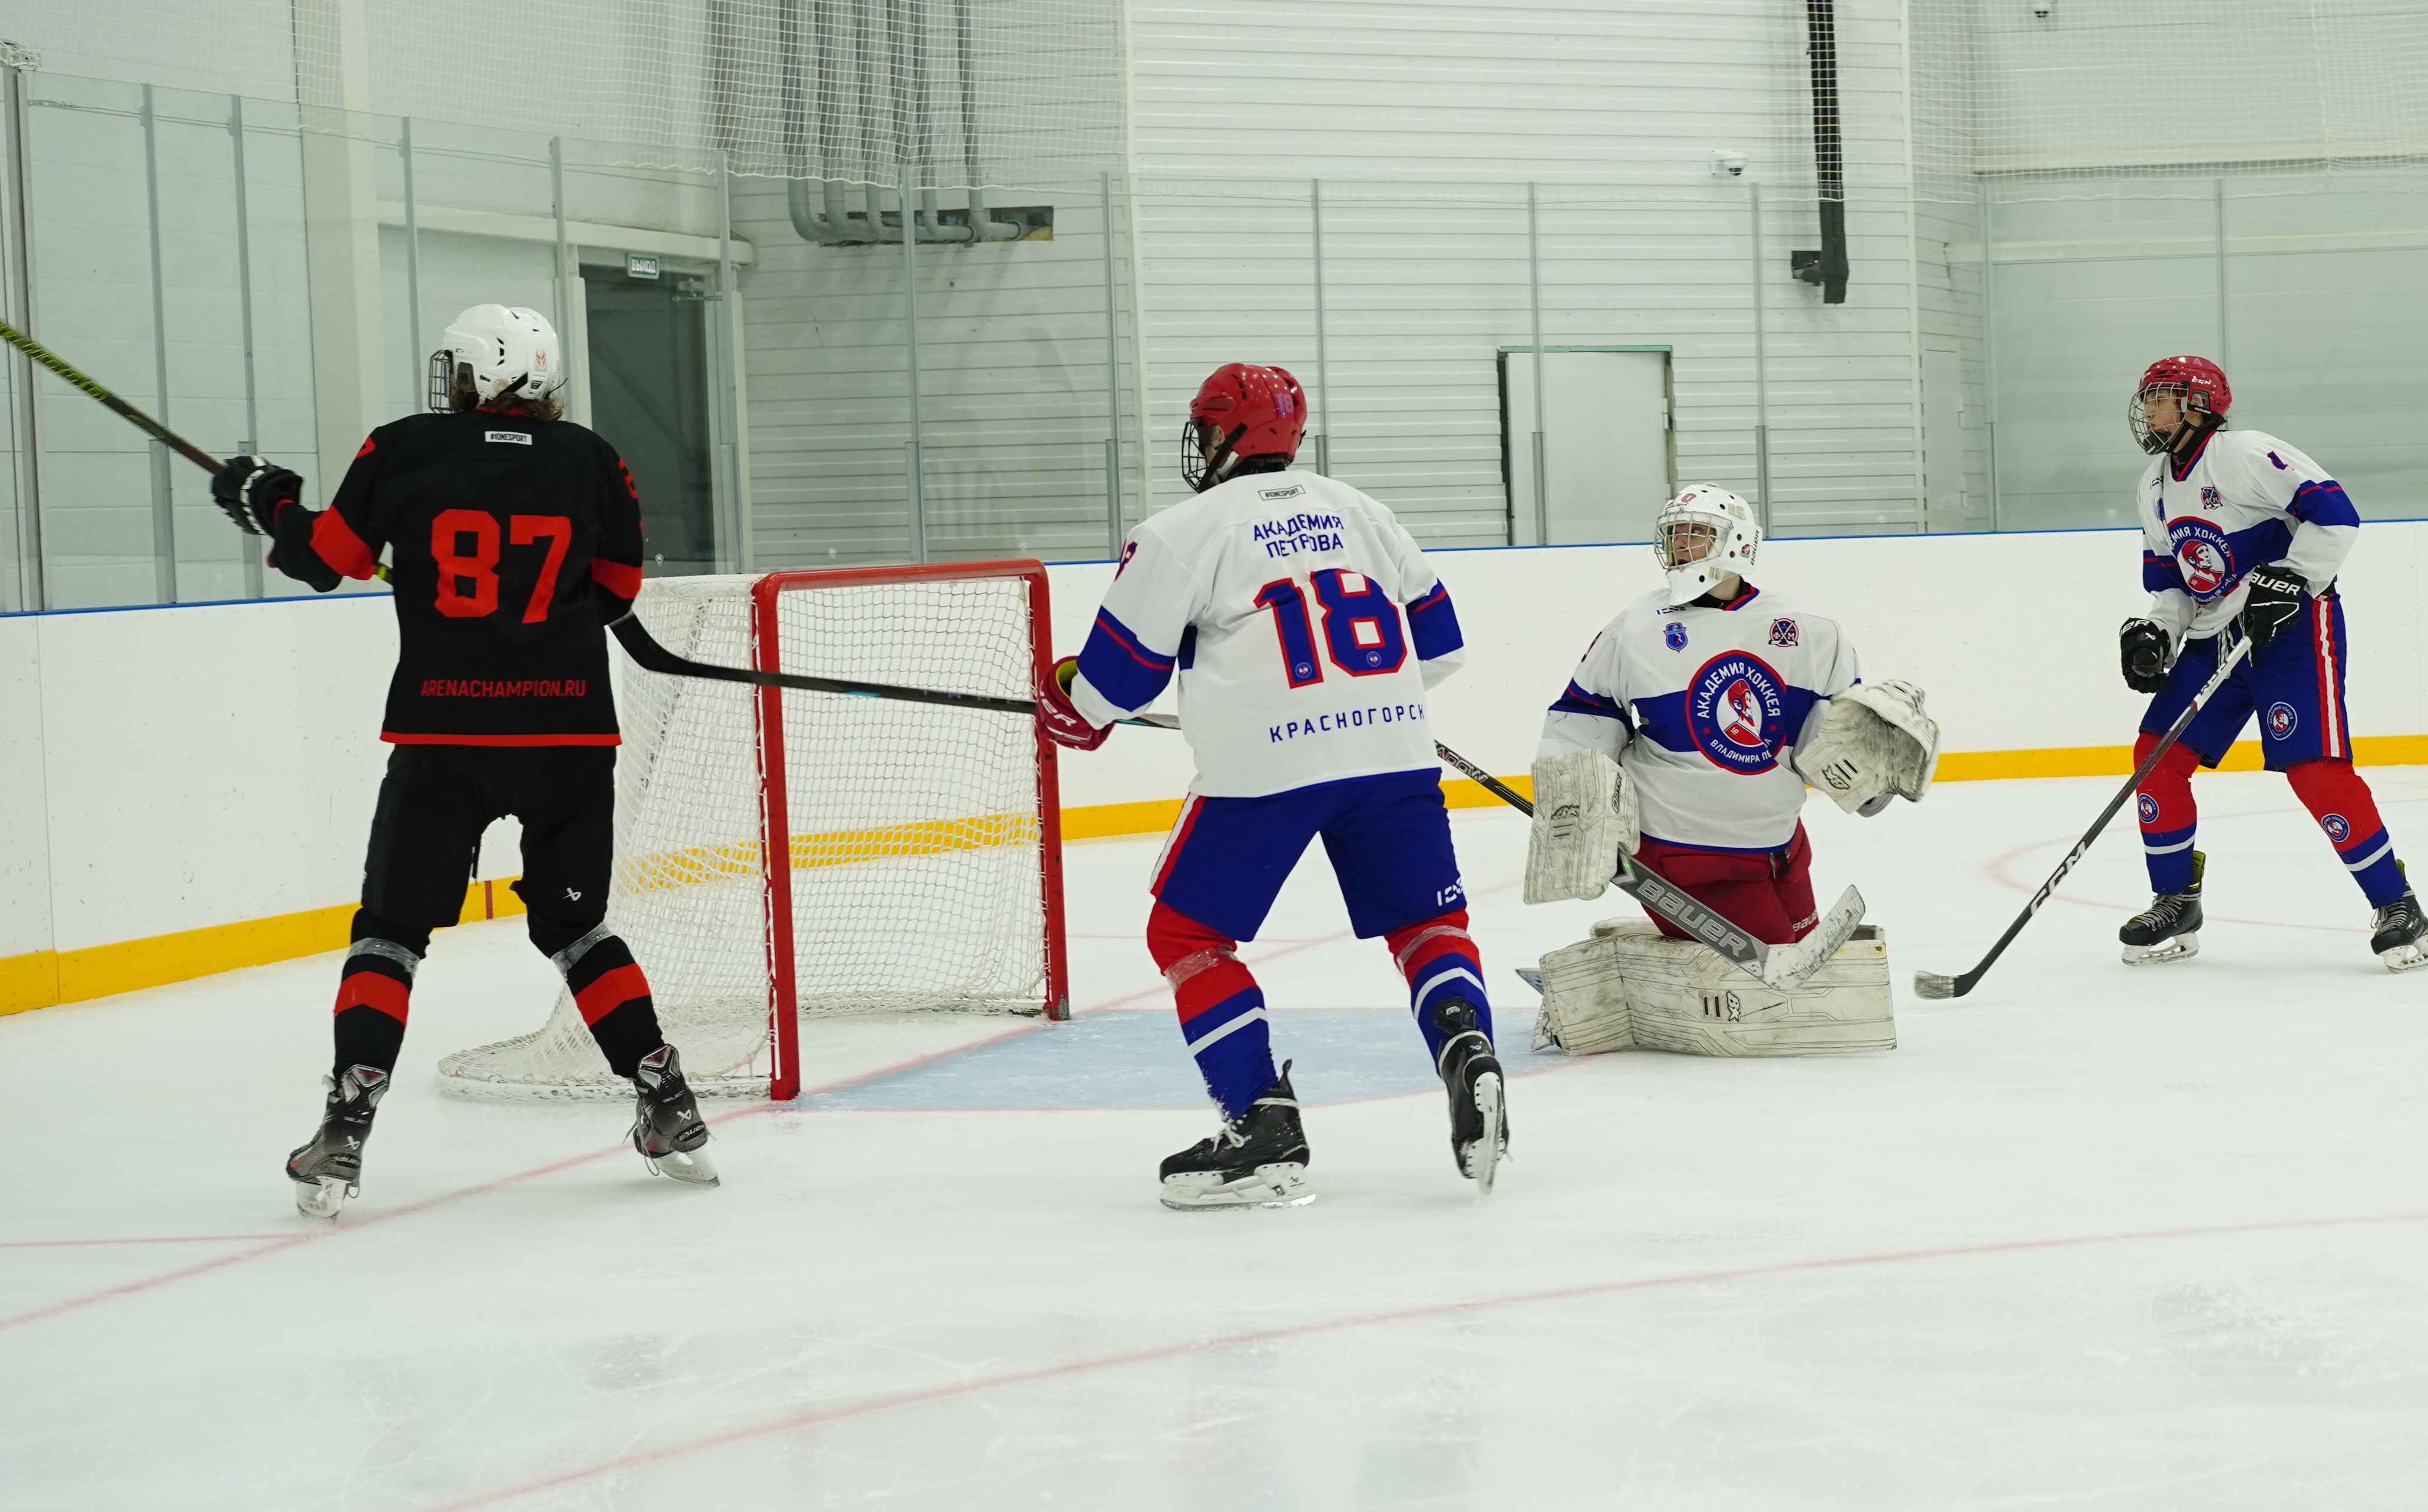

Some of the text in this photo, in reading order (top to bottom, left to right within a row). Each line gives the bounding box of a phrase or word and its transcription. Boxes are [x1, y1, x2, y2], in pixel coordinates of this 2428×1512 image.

[1274, 393, 1295, 415] 18
[1253, 514, 1345, 541] АКАДЕМИЯ
[1266, 533, 1344, 558] ПЕТРОВА
[431, 508, 573, 624] 87
[2250, 572, 2301, 596] AUER
[1253, 568, 1408, 690] 18
[420, 679, 587, 698] ARENACHAMPION.RU
[1696, 662, 1781, 719] АКАДЕМИЯ ХОККЕЯ
[1269, 704, 1425, 743] КРАСНОГОРСК
[1710, 739, 1761, 763] ВЛАДИМИРА
[1636, 878, 1748, 958] BAUER
